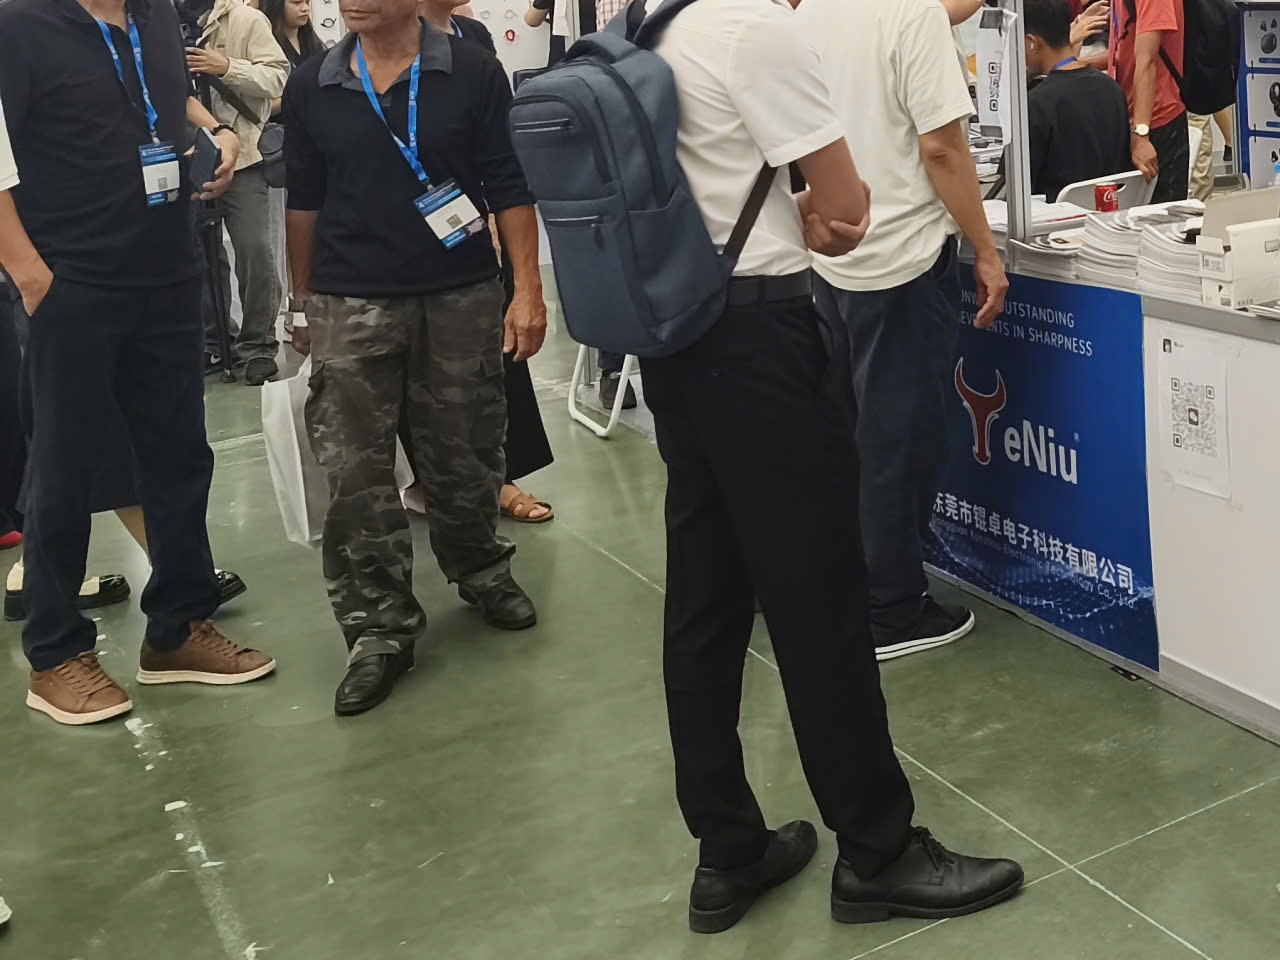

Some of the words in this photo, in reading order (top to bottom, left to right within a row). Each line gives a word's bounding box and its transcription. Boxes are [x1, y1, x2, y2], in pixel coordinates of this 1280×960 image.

[1005, 301, 1075, 328] UTSTANDING
[1013, 324, 1025, 340] IN
[1028, 327, 1093, 357] SHARPNESS
